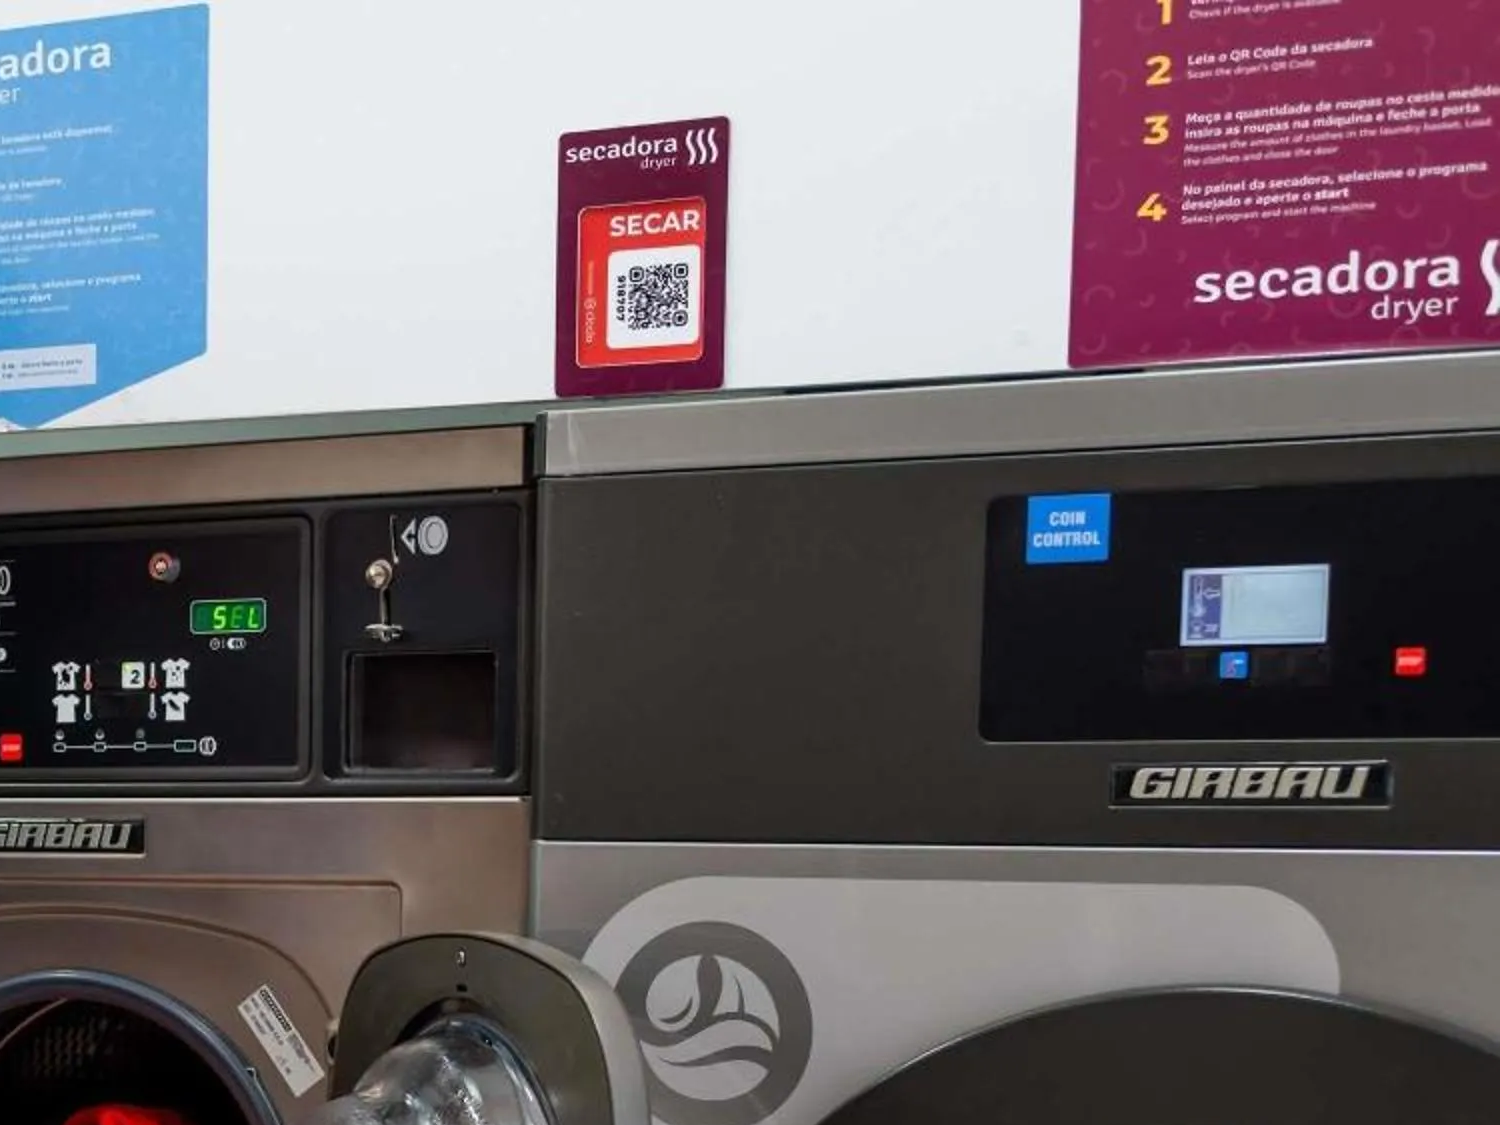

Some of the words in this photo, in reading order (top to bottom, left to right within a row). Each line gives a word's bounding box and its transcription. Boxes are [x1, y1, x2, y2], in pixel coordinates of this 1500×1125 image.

[1156, 0, 1173, 25] 1
[1187, 54, 1215, 66] Leia
[1230, 50, 1250, 62] QR
[1253, 45, 1287, 59] Code
[1290, 44, 1307, 55] da
[1311, 37, 1373, 53] secadora
[1145, 55, 1173, 86] 2
[1235, 101, 1312, 121] quantidade
[1315, 100, 1332, 112] de
[1243, 120, 1289, 134] roupas
[1441, 102, 1481, 118] porta
[1143, 114, 1169, 145] 3
[566, 136, 677, 163] secadora
[641, 156, 676, 171] dryer
[1183, 184, 1201, 196] No
[1249, 178, 1265, 190] da
[1418, 161, 1488, 179] programa
[1136, 192, 1167, 221] 4
[1314, 187, 1349, 200] start
[610, 209, 700, 238] SECAR
[1194, 250, 1461, 303] secadora
[1370, 295, 1458, 325] dryer
[1048, 510, 1085, 528] COIN
[1033, 530, 1101, 548] CONTROL
[213, 604, 260, 630] SEL
[129, 669, 141, 685] 2
[1129, 765, 1372, 799] GIRBAU
